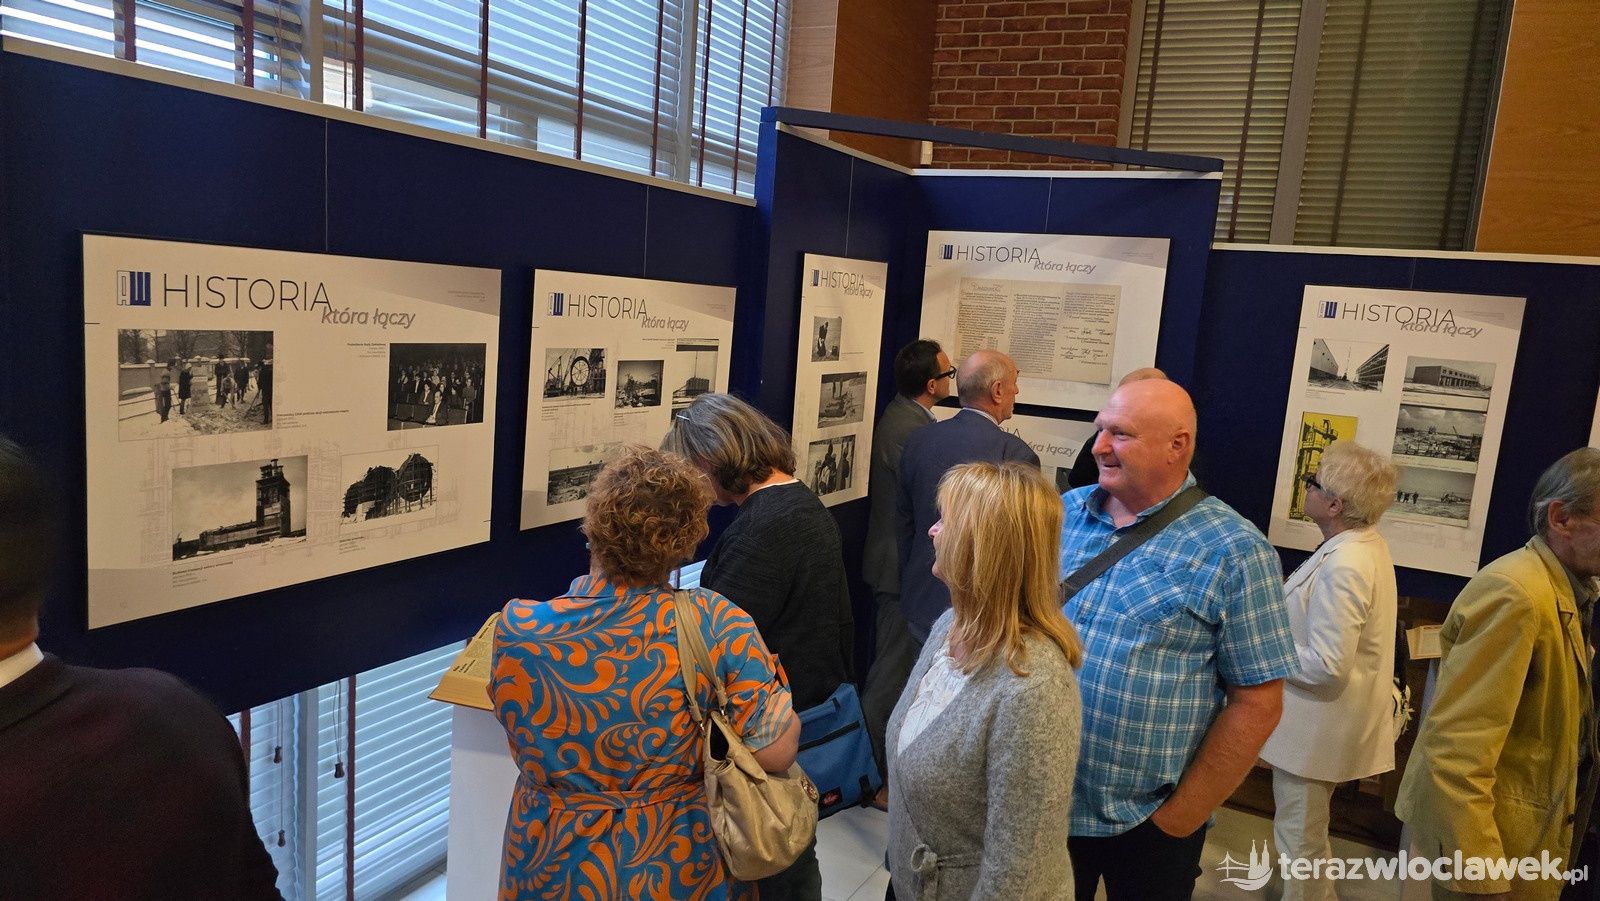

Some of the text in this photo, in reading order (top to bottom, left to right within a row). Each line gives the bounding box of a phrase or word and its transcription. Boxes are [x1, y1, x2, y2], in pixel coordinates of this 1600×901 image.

[956, 245, 1042, 264] HISTORIA
[1033, 259, 1097, 274] która łączy
[820, 270, 865, 290] HISTORIA
[163, 273, 333, 312] HISTORIA
[567, 293, 648, 320] HISTORIA
[1341, 302, 1456, 327] HISTORIA
[320, 306, 417, 329] która łączy
[641, 315, 690, 332] która łączy
[1399, 320, 1483, 338] która łączy
[1045, 442, 1077, 458] łączy
